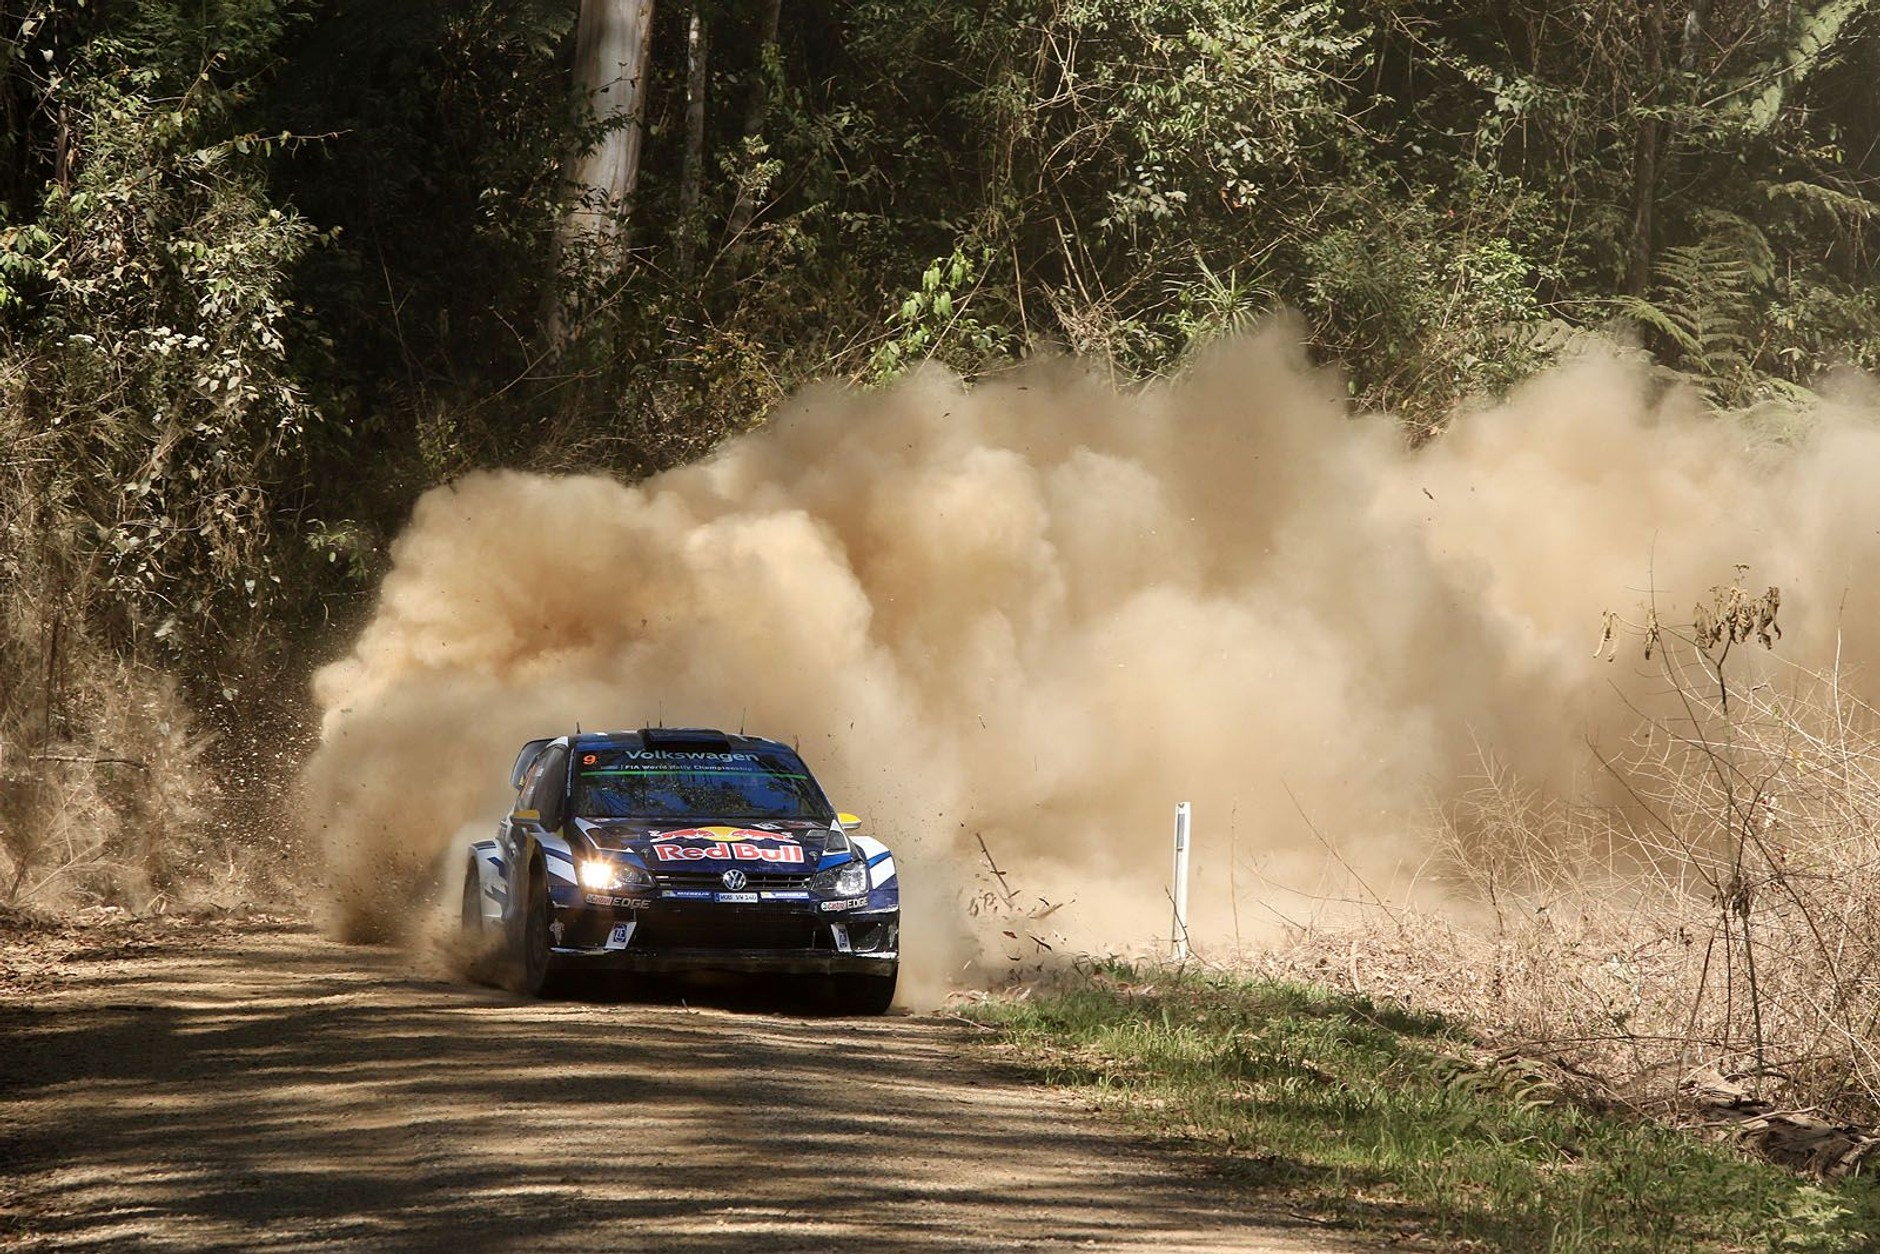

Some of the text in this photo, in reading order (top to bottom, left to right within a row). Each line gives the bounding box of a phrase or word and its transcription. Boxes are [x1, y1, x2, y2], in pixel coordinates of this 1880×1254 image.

[583, 754, 596, 766] 9
[625, 749, 760, 763] Volkswagen
[654, 843, 804, 863] Red Bull
[612, 897, 651, 909] EDGE
[847, 897, 868, 908] EDGE
